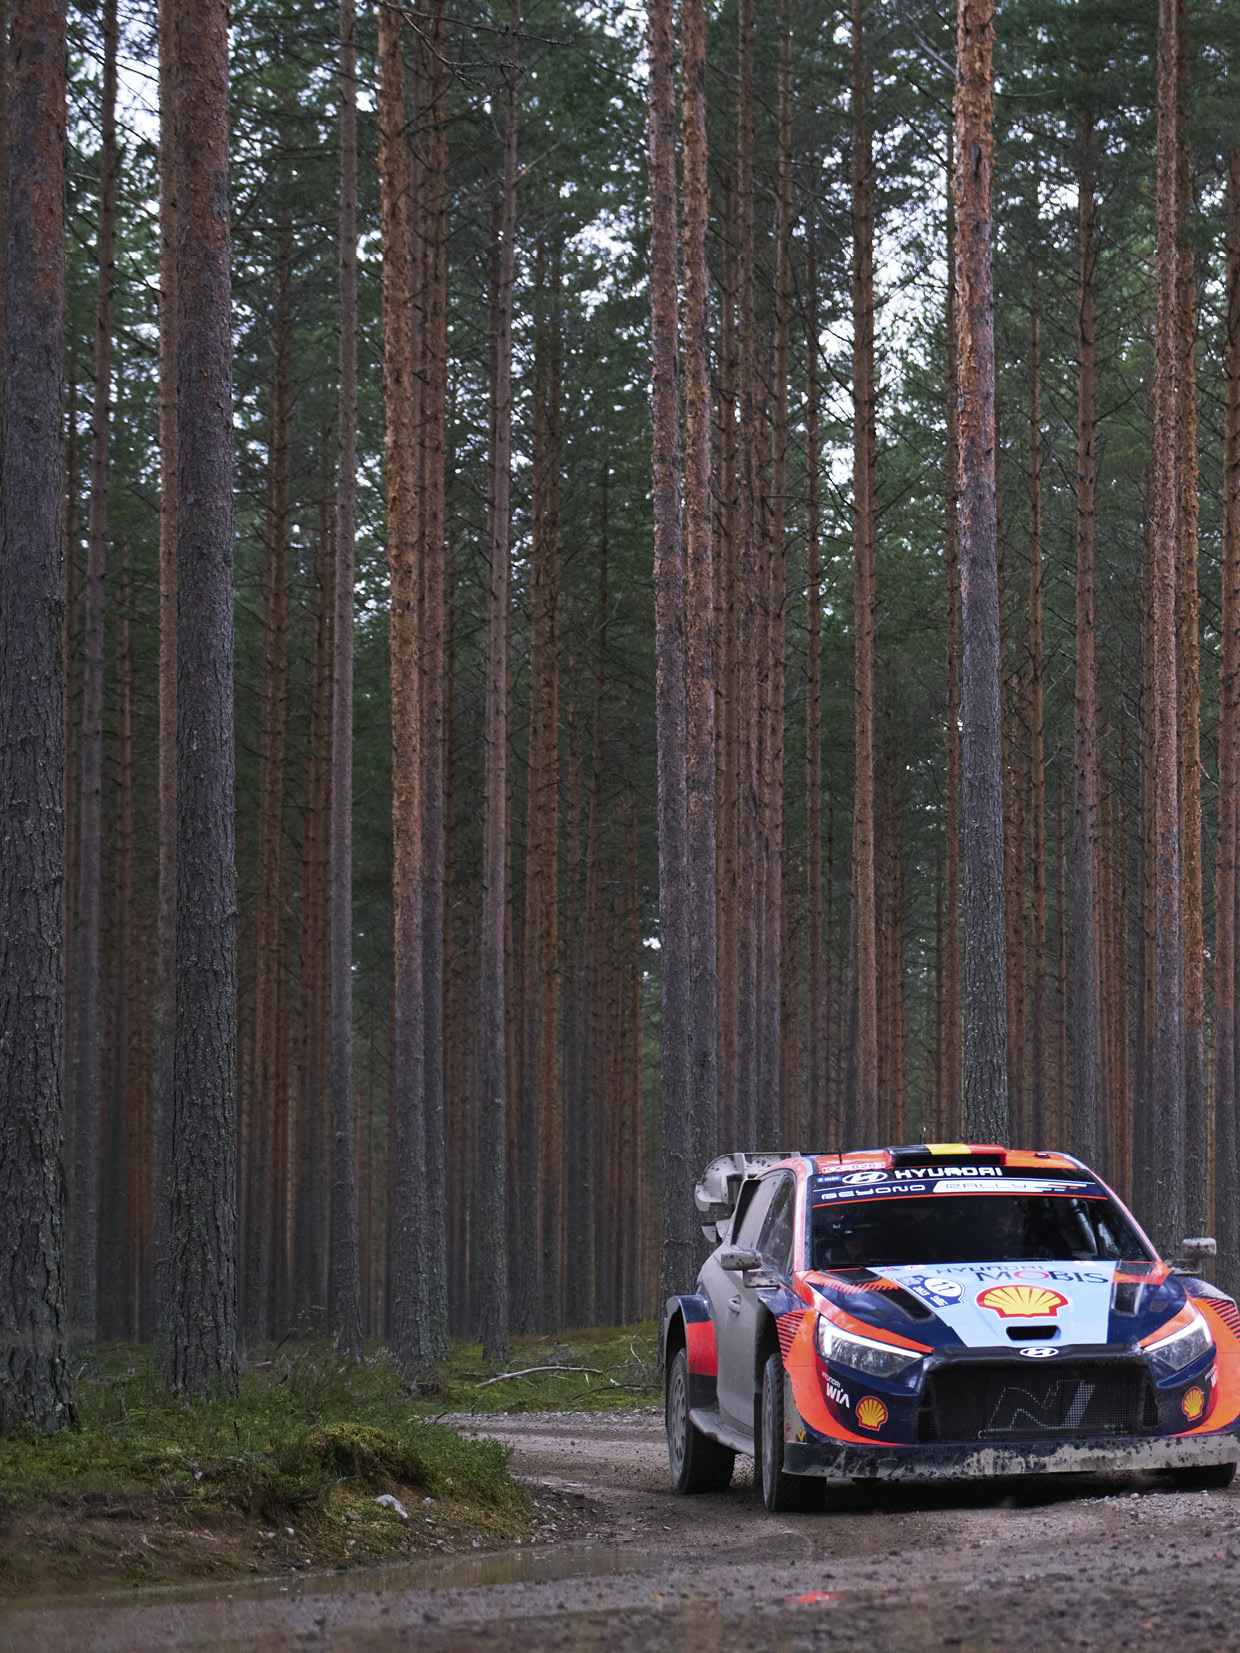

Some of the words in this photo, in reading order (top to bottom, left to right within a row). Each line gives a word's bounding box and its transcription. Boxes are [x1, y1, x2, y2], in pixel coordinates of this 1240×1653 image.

[895, 1167, 1003, 1179] HYUNDAI
[821, 1184, 926, 1200] BEYOND
[936, 1265, 1044, 1274] HYUNDAI
[975, 1270, 1109, 1284] MOBIS
[931, 1282, 956, 1292] 11
